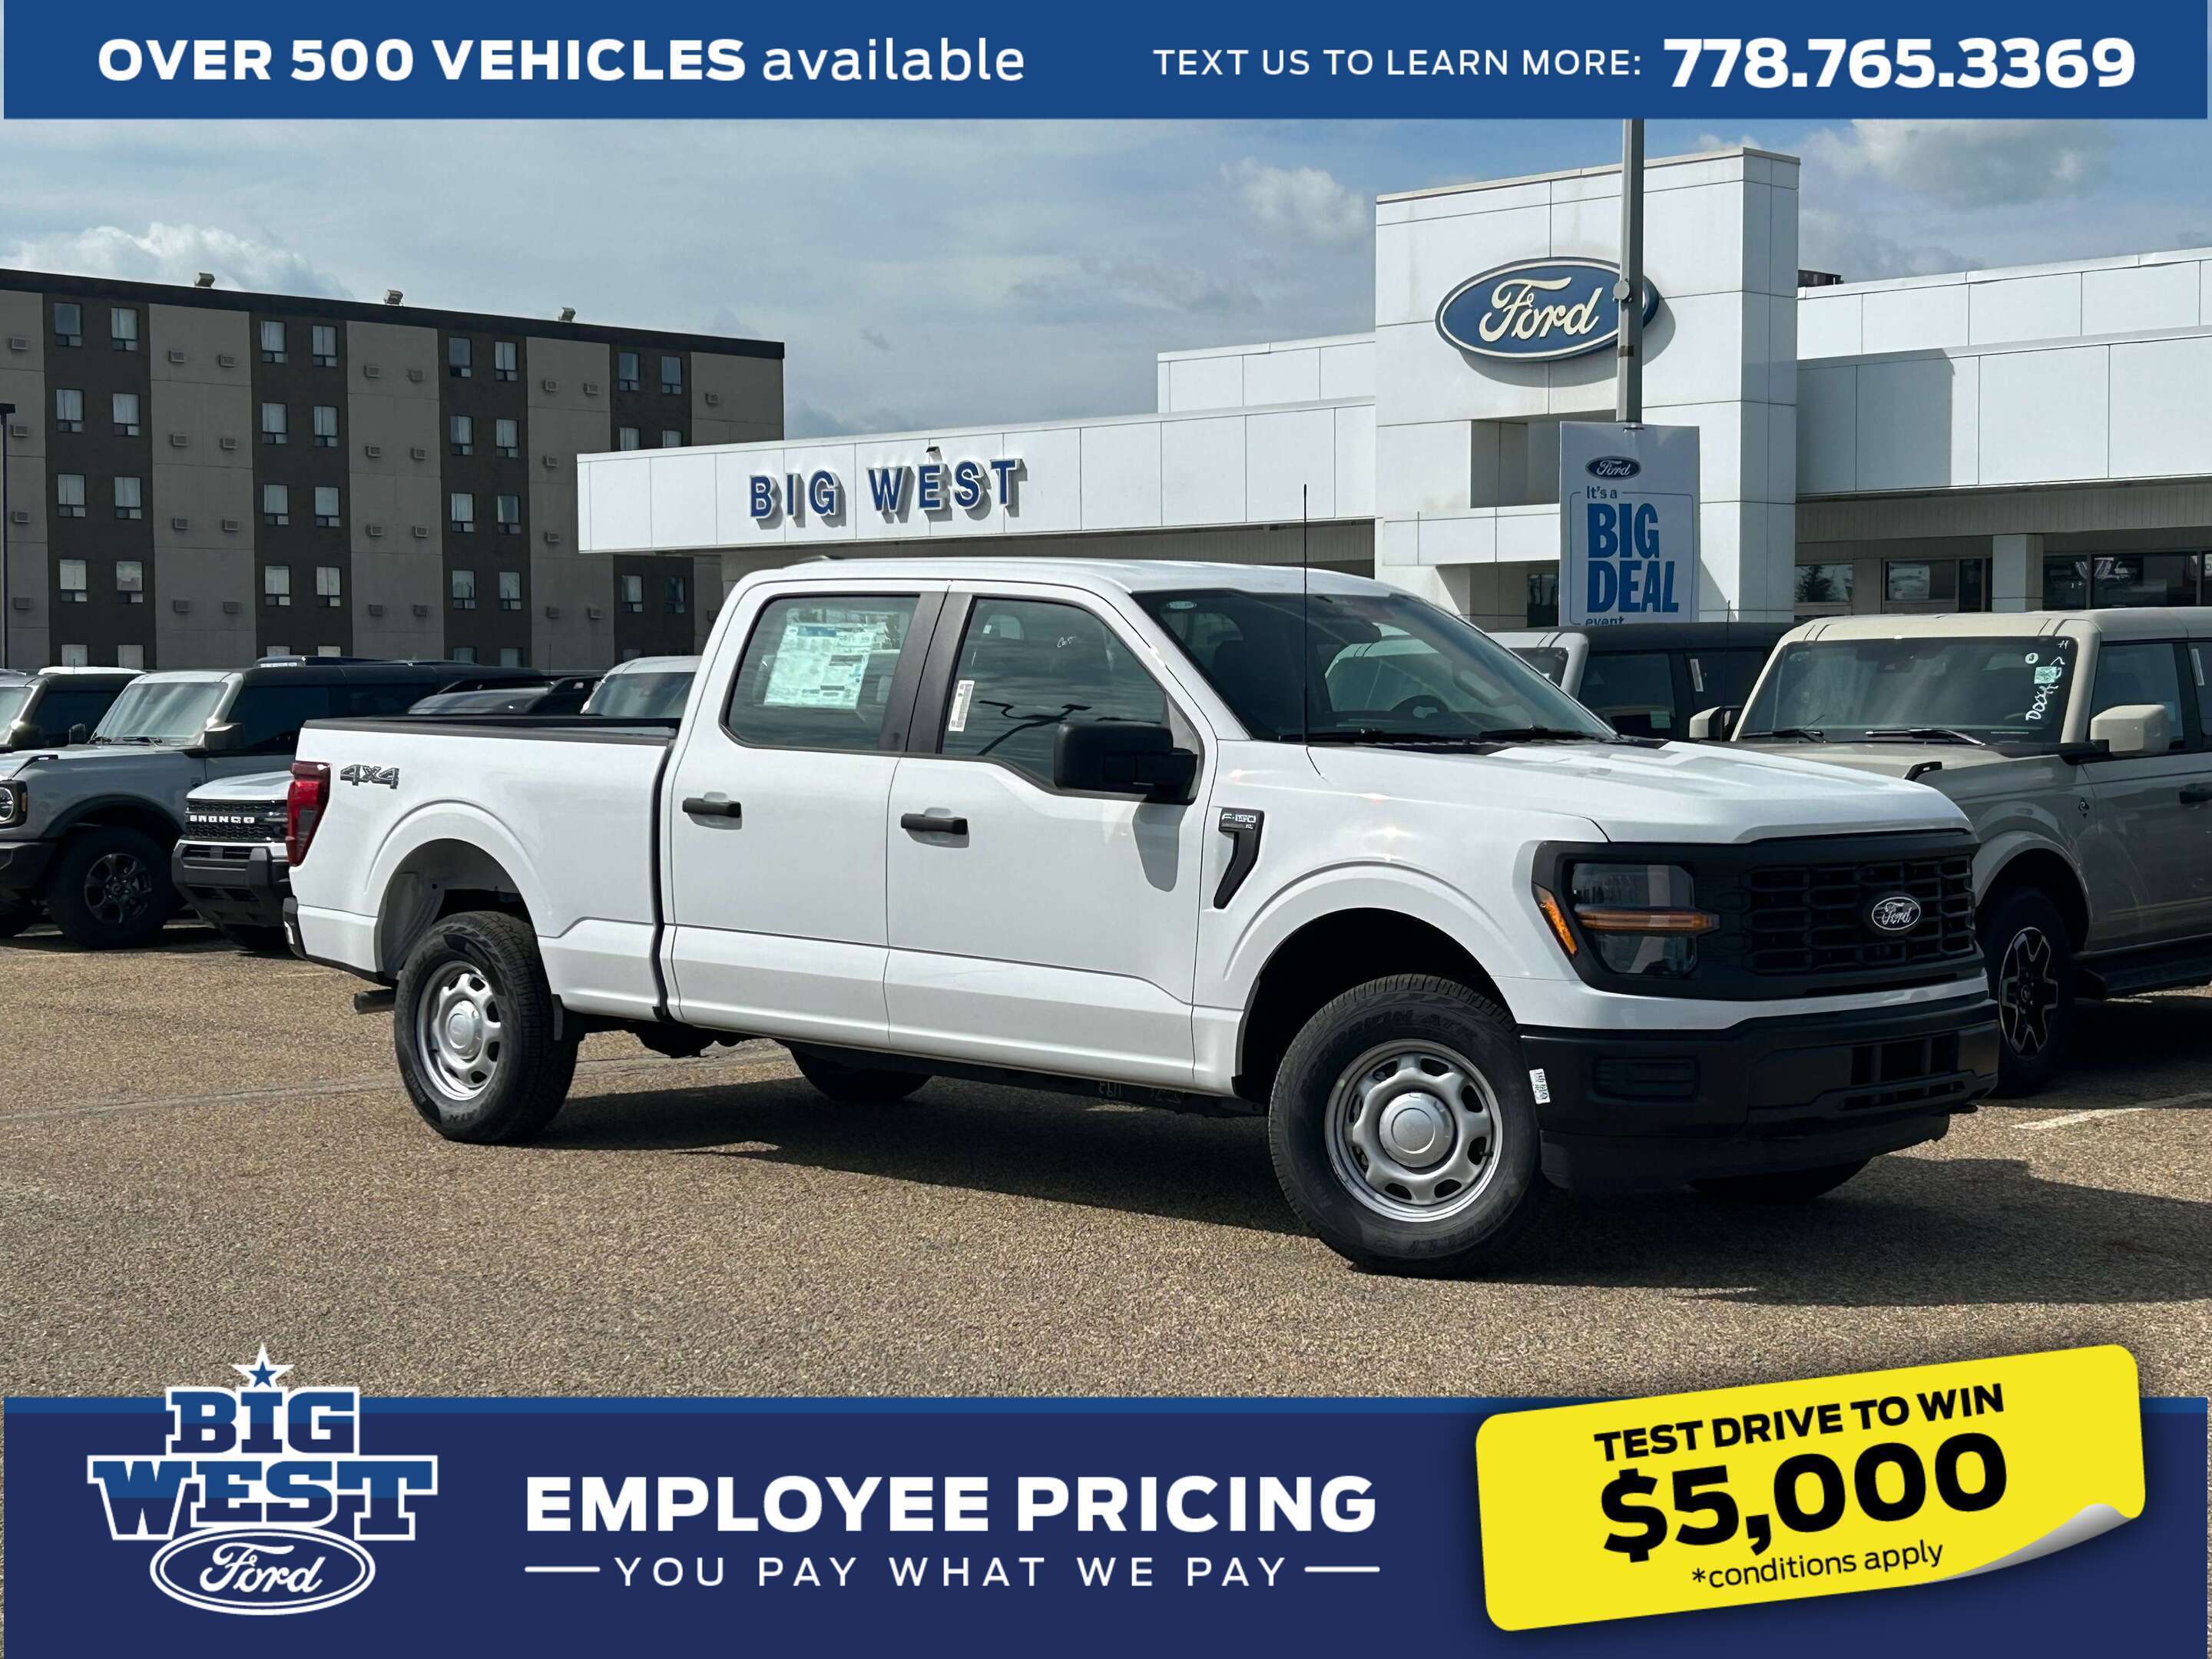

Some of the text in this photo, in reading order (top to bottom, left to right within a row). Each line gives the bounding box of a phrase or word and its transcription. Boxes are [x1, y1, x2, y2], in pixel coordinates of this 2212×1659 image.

[1479, 276, 1604, 343] Ford
[1595, 460, 1631, 476] Ford
[750, 458, 1018, 518] BIG WEST
[1586, 485, 1618, 499] It's a
[1587, 502, 1660, 559] BIG
[1587, 560, 1679, 613] DEAL
[189, 814, 255, 824] BRONCO
[1881, 902, 1912, 926] Ford
